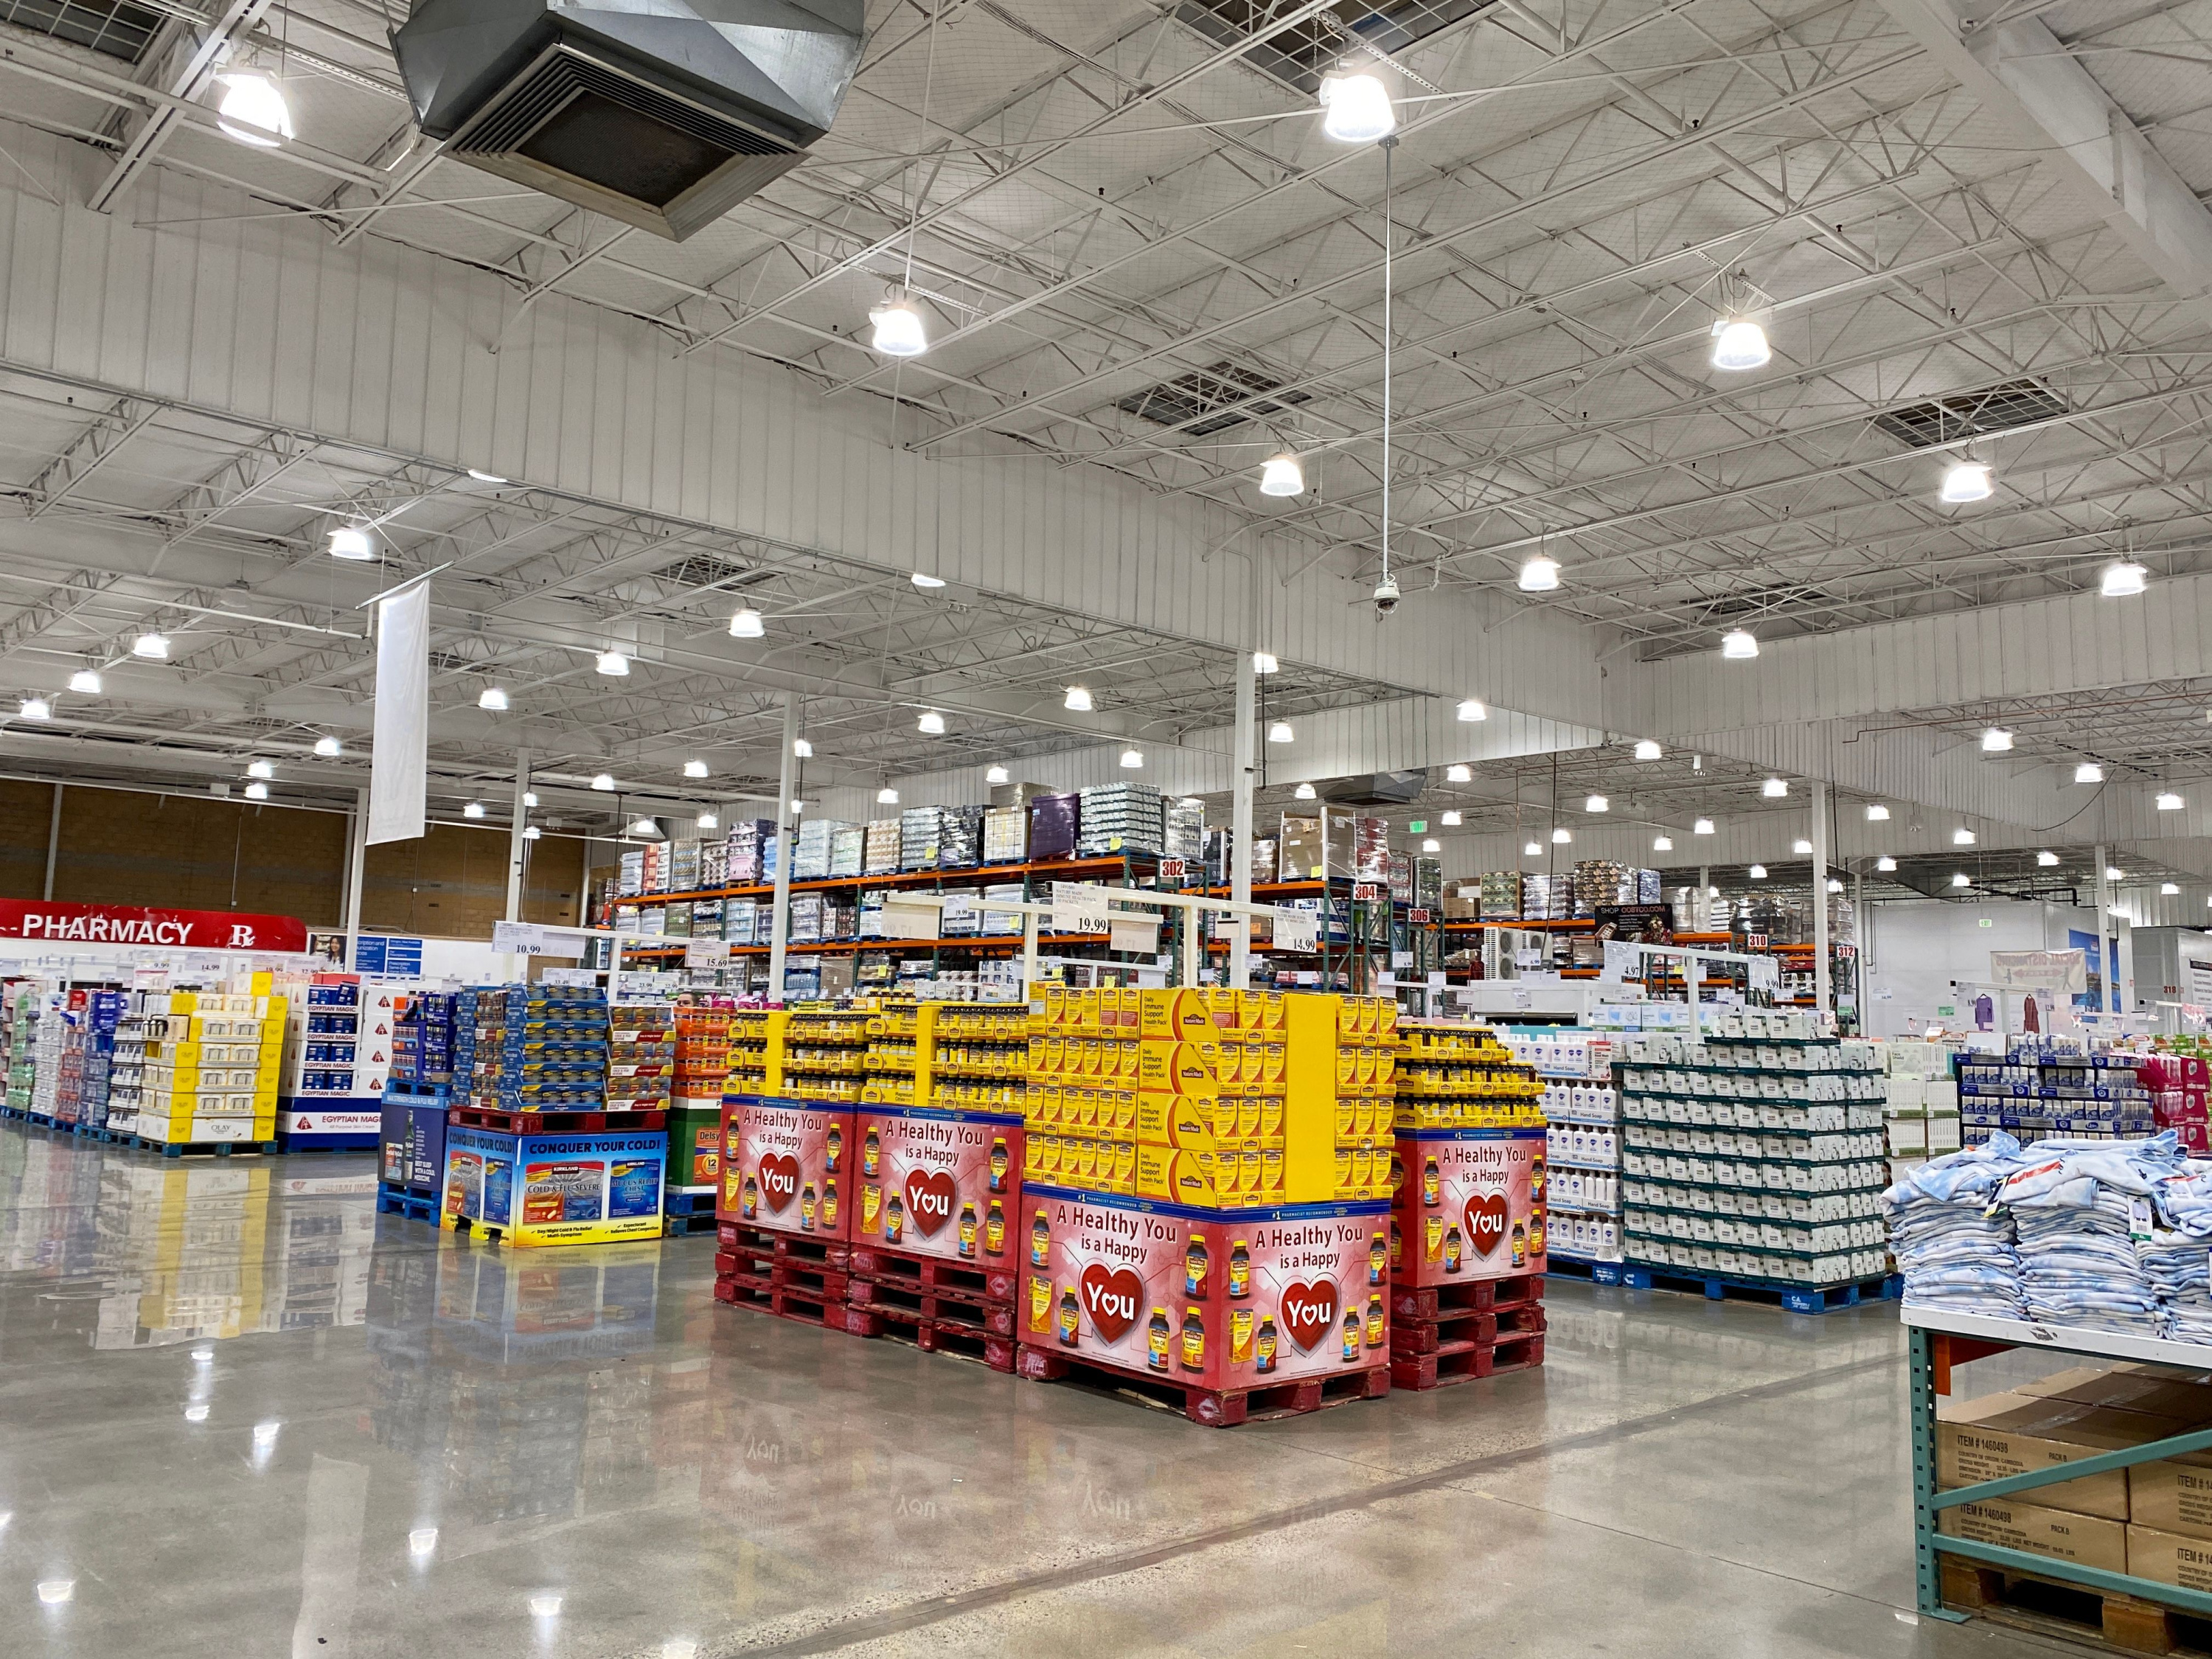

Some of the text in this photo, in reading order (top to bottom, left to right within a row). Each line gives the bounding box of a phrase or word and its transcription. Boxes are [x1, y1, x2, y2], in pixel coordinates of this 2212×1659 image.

[1162, 861, 1183, 876] 302
[1355, 886, 1375, 899] 304
[1410, 909, 1427, 922] 306
[22, 914, 193, 945] PHARMACY
[1079, 917, 1106, 932] 19.99
[1293, 938, 1315, 950] 14.99
[1750, 936, 1766, 946] 310
[517, 945, 540, 954] 10.99
[1839, 947, 1854, 956] 312
[707, 959, 727, 967] 15.69
[1625, 966, 1638, 975] 4.97
[1766, 980, 1778, 989] 9.99
[744, 1110, 822, 1132] A Healthy You
[1140, 1115, 1159, 1123] Support
[759, 1131, 765, 1142] is
[775, 1132, 803, 1150] Happy
[886, 1121, 983, 1146] A Healthy You
[449, 1133, 515, 1154] CONQUER YOUR COLD!
[529, 1140, 660, 1154] CONQUER YOUR COLD!
[905, 1144, 913, 1158] is
[925, 1146, 959, 1166] Happy
[1443, 1147, 1526, 1166] A Healthy You
[762, 1167, 793, 1194] You
[1463, 1169, 1470, 1182] is
[1480, 1169, 1509, 1184] Happy
[528, 1185, 550, 1193] COLD
[909, 1186, 949, 1215] You
[1078, 1194, 1085, 1202] #1
[1110, 1199, 1137, 1208] RECOMMENDED
[1273, 1211, 1281, 1220] #1
[1468, 1211, 1502, 1234] You
[1057, 1205, 1067, 1223] A
[1074, 1207, 1138, 1240] Healthy
[1144, 1218, 1177, 1242] You
[1256, 1225, 1363, 1249] A Healthy You
[1082, 1234, 1147, 1264] is a Happy
[1280, 1253, 1340, 1270] is a Happy
[1086, 1282, 1135, 1321] You
[1287, 1300, 1331, 1326] You
[1958, 1435, 1974, 1447] ITEM
[1981, 1439, 2008, 1453] 1460498
[2001, 1458, 2023, 1467] CAMBODIA
[1961, 1503, 1977, 1515] ITEM
[1984, 1509, 2011, 1523] 1460498
[2051, 1525, 2065, 1534] PACK
